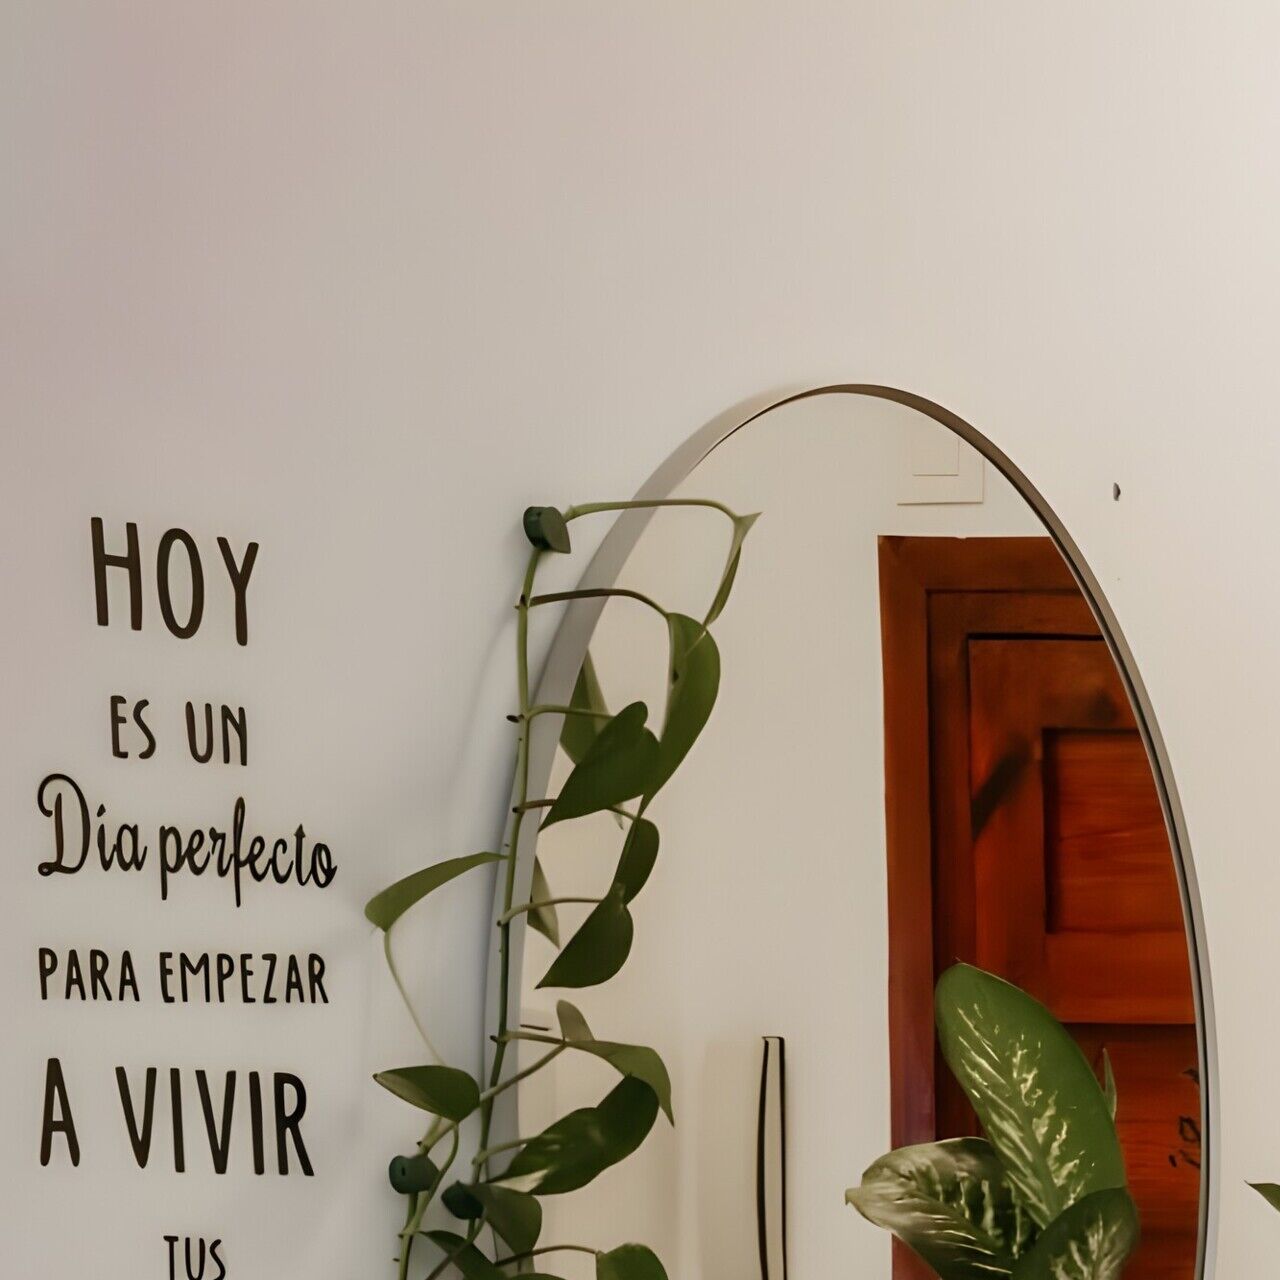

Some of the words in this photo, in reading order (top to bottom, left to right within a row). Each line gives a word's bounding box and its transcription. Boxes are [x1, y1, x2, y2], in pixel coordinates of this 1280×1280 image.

[90, 516, 260, 647] HOY
[110, 694, 157, 760] ES
[185, 701, 248, 767] UN
[158, 796, 338, 908] perfecto
[38, 947, 141, 1003] PARA
[159, 951, 330, 1004] EMPEZAR
[39, 1057, 81, 1168] A
[114, 1066, 316, 1177] VIVIR
